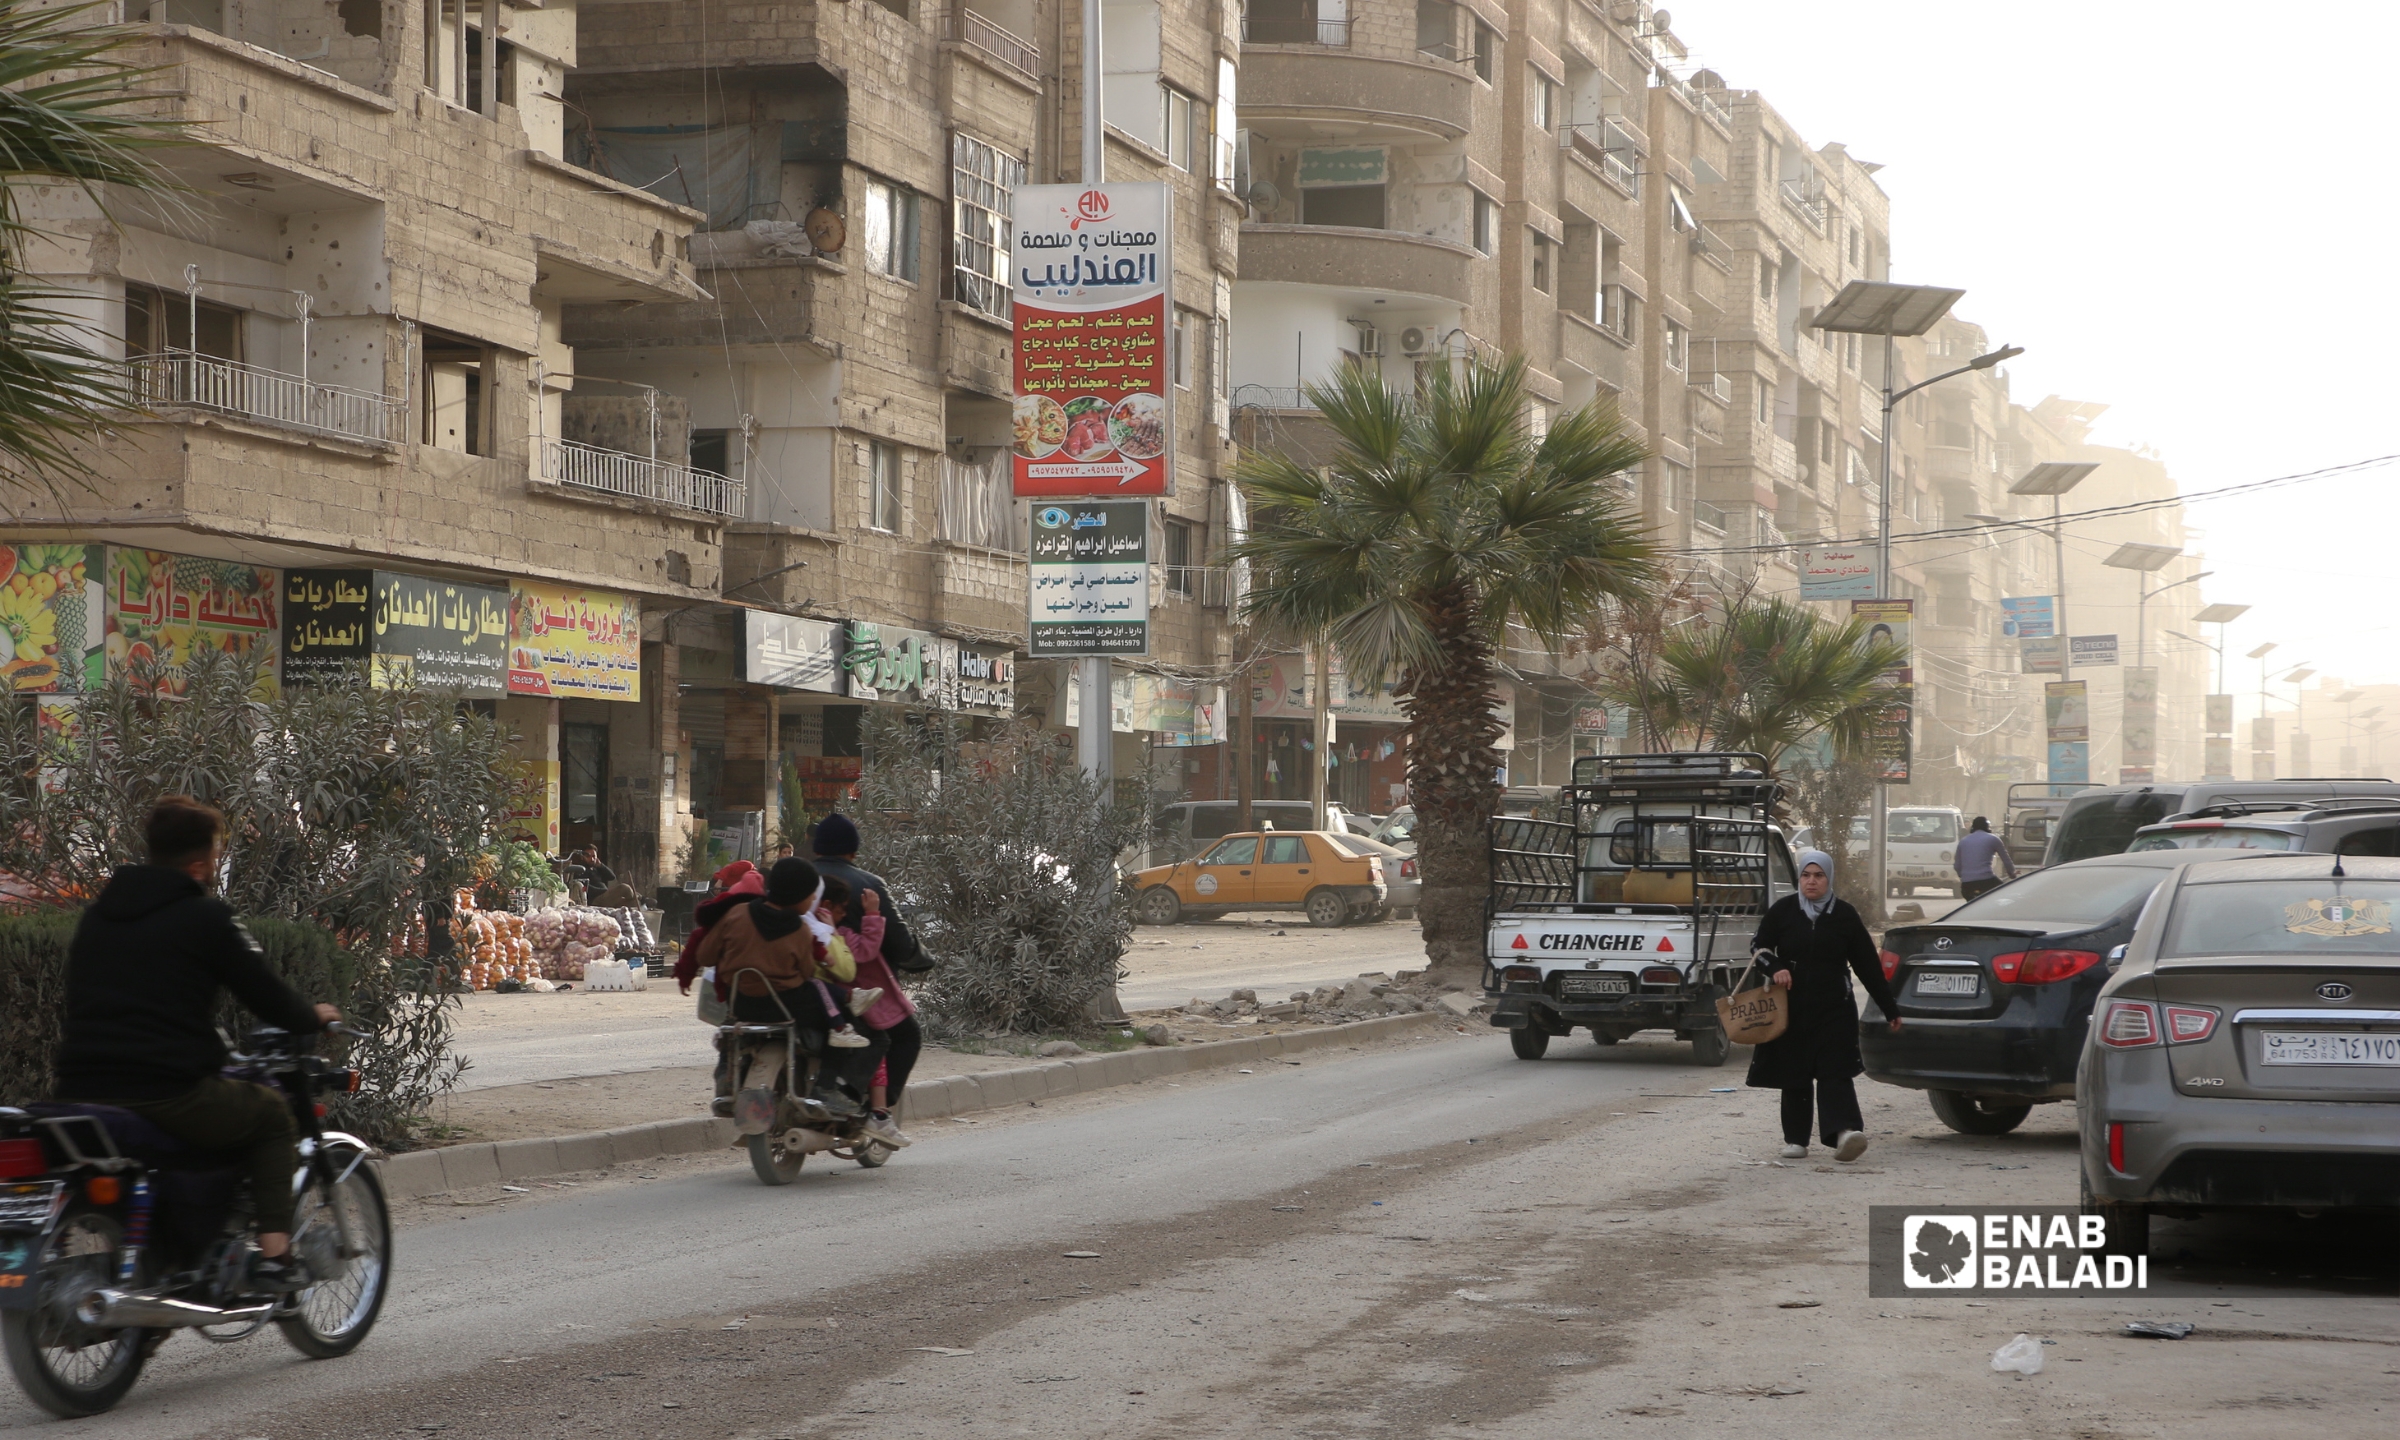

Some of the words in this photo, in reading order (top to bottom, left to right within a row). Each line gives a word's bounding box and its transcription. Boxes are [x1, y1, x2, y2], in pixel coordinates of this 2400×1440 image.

[1021, 231, 1072, 249] ملحمة
[1079, 233, 1088, 252] و
[1094, 230, 1157, 251] معجنات
[1022, 253, 1156, 296] العندليب
[1022, 316, 1054, 331] عجل
[1057, 315, 1085, 331] لحم
[1096, 313, 1123, 330] غنم
[1126, 313, 1154, 330] لحم
[1022, 337, 1050, 352] دجاج
[1053, 335, 1079, 351] كباب
[1090, 335, 1118, 351] دجاج
[1121, 330, 1156, 351] مشاوي
[1025, 355, 1064, 372] بيتزا
[1074, 352, 1125, 372] مشوية
[1128, 352, 1154, 370] كبة
[1024, 373, 1066, 392] بأنواعها
[1069, 375, 1109, 391] معجنات
[1119, 374, 1151, 392] سجق
[1071, 511, 1107, 530] الدكتور
[1075, 535, 1106, 555] ابراهيم
[1108, 535, 1142, 555] اسماعيل
[1824, 552, 1855, 560] صيدلية
[1807, 567, 1837, 575] محمد
[1839, 565, 1870, 577] هنادي
[1069, 572, 1084, 590] في
[1086, 571, 1141, 591] اختصاصي
[119, 567, 190, 629] داريا
[288, 576, 367, 612] بطاريات
[197, 578, 269, 644] جنة
[375, 580, 437, 635] العدنان
[1046, 597, 1098, 614] وجراحتها
[1100, 597, 1132, 613] العين
[442, 587, 507, 650] بطاريات
[533, 594, 576, 636] دنون
[580, 597, 622, 644] بزورية
[291, 619, 363, 652] العدنان
[1055, 627, 1066, 636] بناء
[1072, 626, 1094, 636] المعضمية
[1096, 626, 1112, 637] طريق
[1114, 626, 1124, 636] أول
[1129, 628, 1142, 636] داريا
[2085, 641, 2115, 649] TECNO
[416, 647, 435, 664] بطاريات
[464, 652, 479, 667] شمسية
[480, 653, 491, 667] طاقة
[577, 651, 600, 669] التوابل
[618, 656, 638, 670] كافة
[551, 670, 590, 692] والمعلبات
[1003, 663, 1014, 682] LG
[592, 674, 630, 695] والبقوليات
[1539, 934, 1645, 951] CHANGHE
[2322, 988, 2346, 997] KIA
[1730, 997, 1778, 1021] PRADA
[2269, 1036, 2316, 1048] دمشق
[2339, 1037, 2400, 1059] ٦٤١٧٥
[2271, 1049, 2318, 1059] 641753
[2185, 1076, 2225, 1087] 4WD
